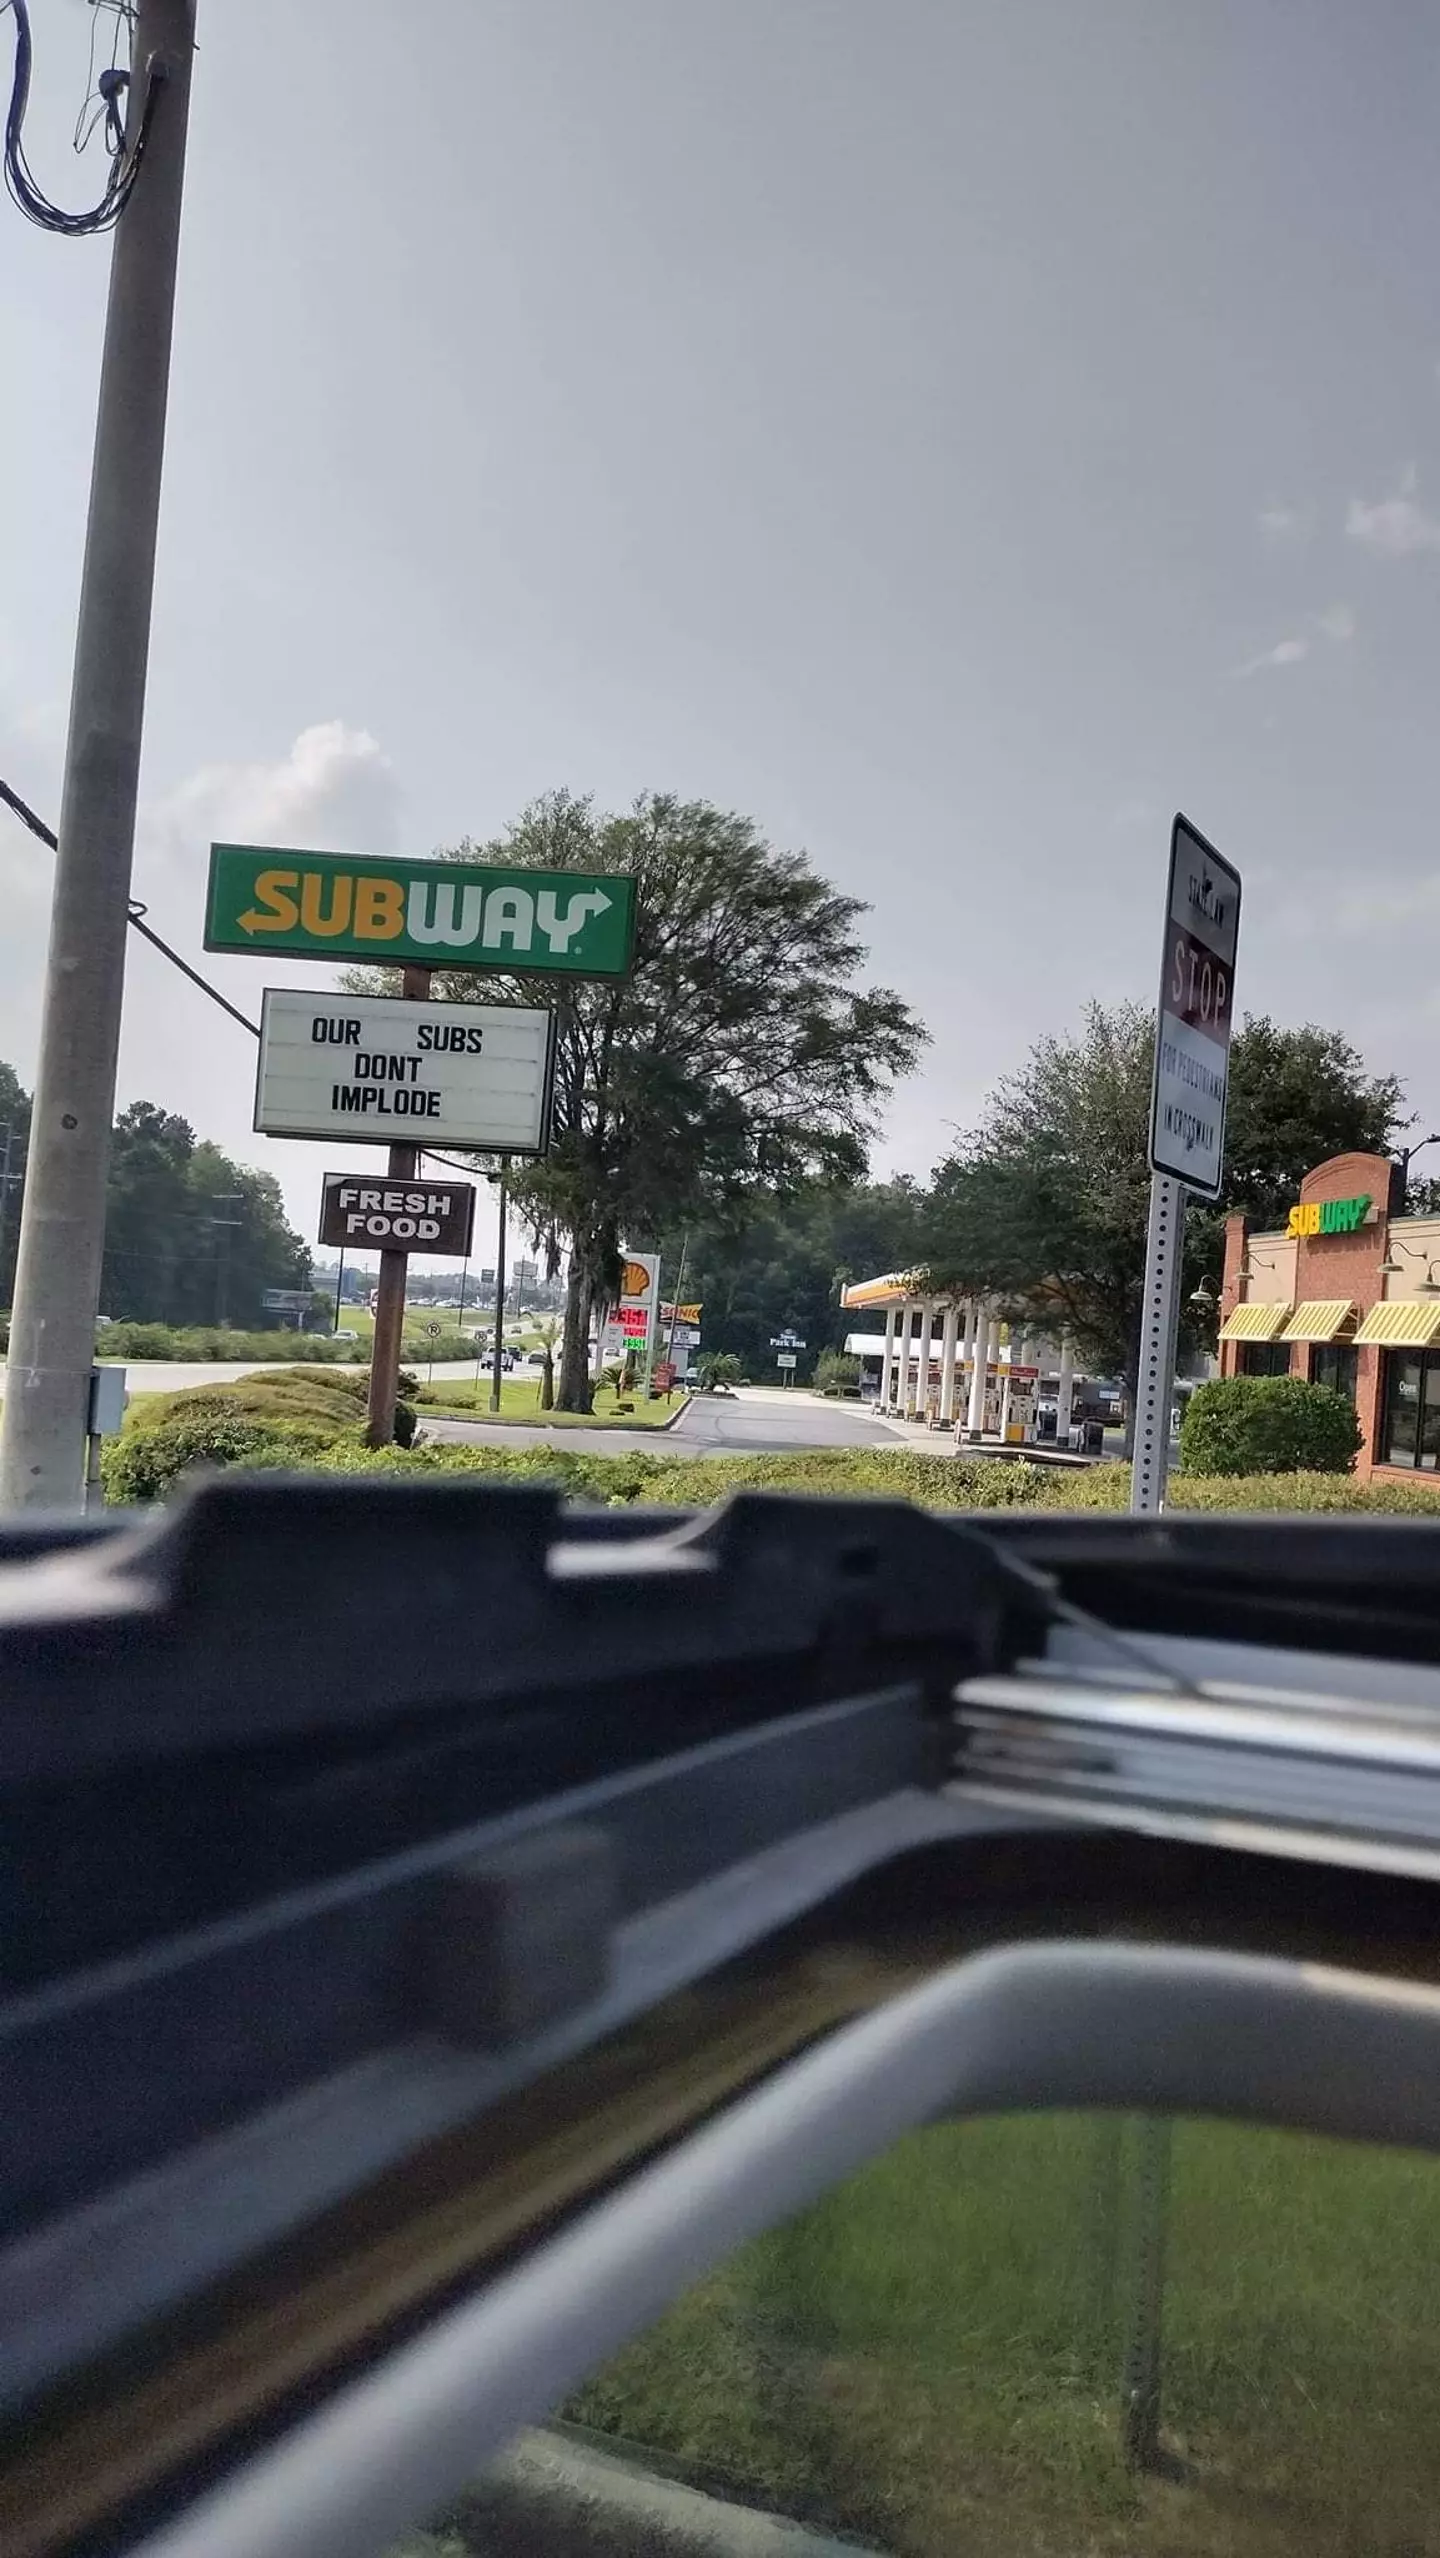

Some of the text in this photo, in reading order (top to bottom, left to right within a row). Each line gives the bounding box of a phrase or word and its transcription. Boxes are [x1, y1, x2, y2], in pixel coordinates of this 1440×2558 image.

[236, 870, 612, 954] SUBWAY
[1172, 940, 1226, 1028] STOP
[312, 1017, 483, 1053] OUR SUBS
[354, 1053, 422, 1082] DONT
[1162, 1042, 1222, 1102] FOR PEDESTRIANS
[332, 1085, 441, 1117] IMPLODE
[1163, 1103, 1214, 1153] IN CROSSWALK
[340, 1189, 451, 1215] FRESH
[1284, 1194, 1371, 1239] SUBWAY
[347, 1214, 440, 1239] FOOD
